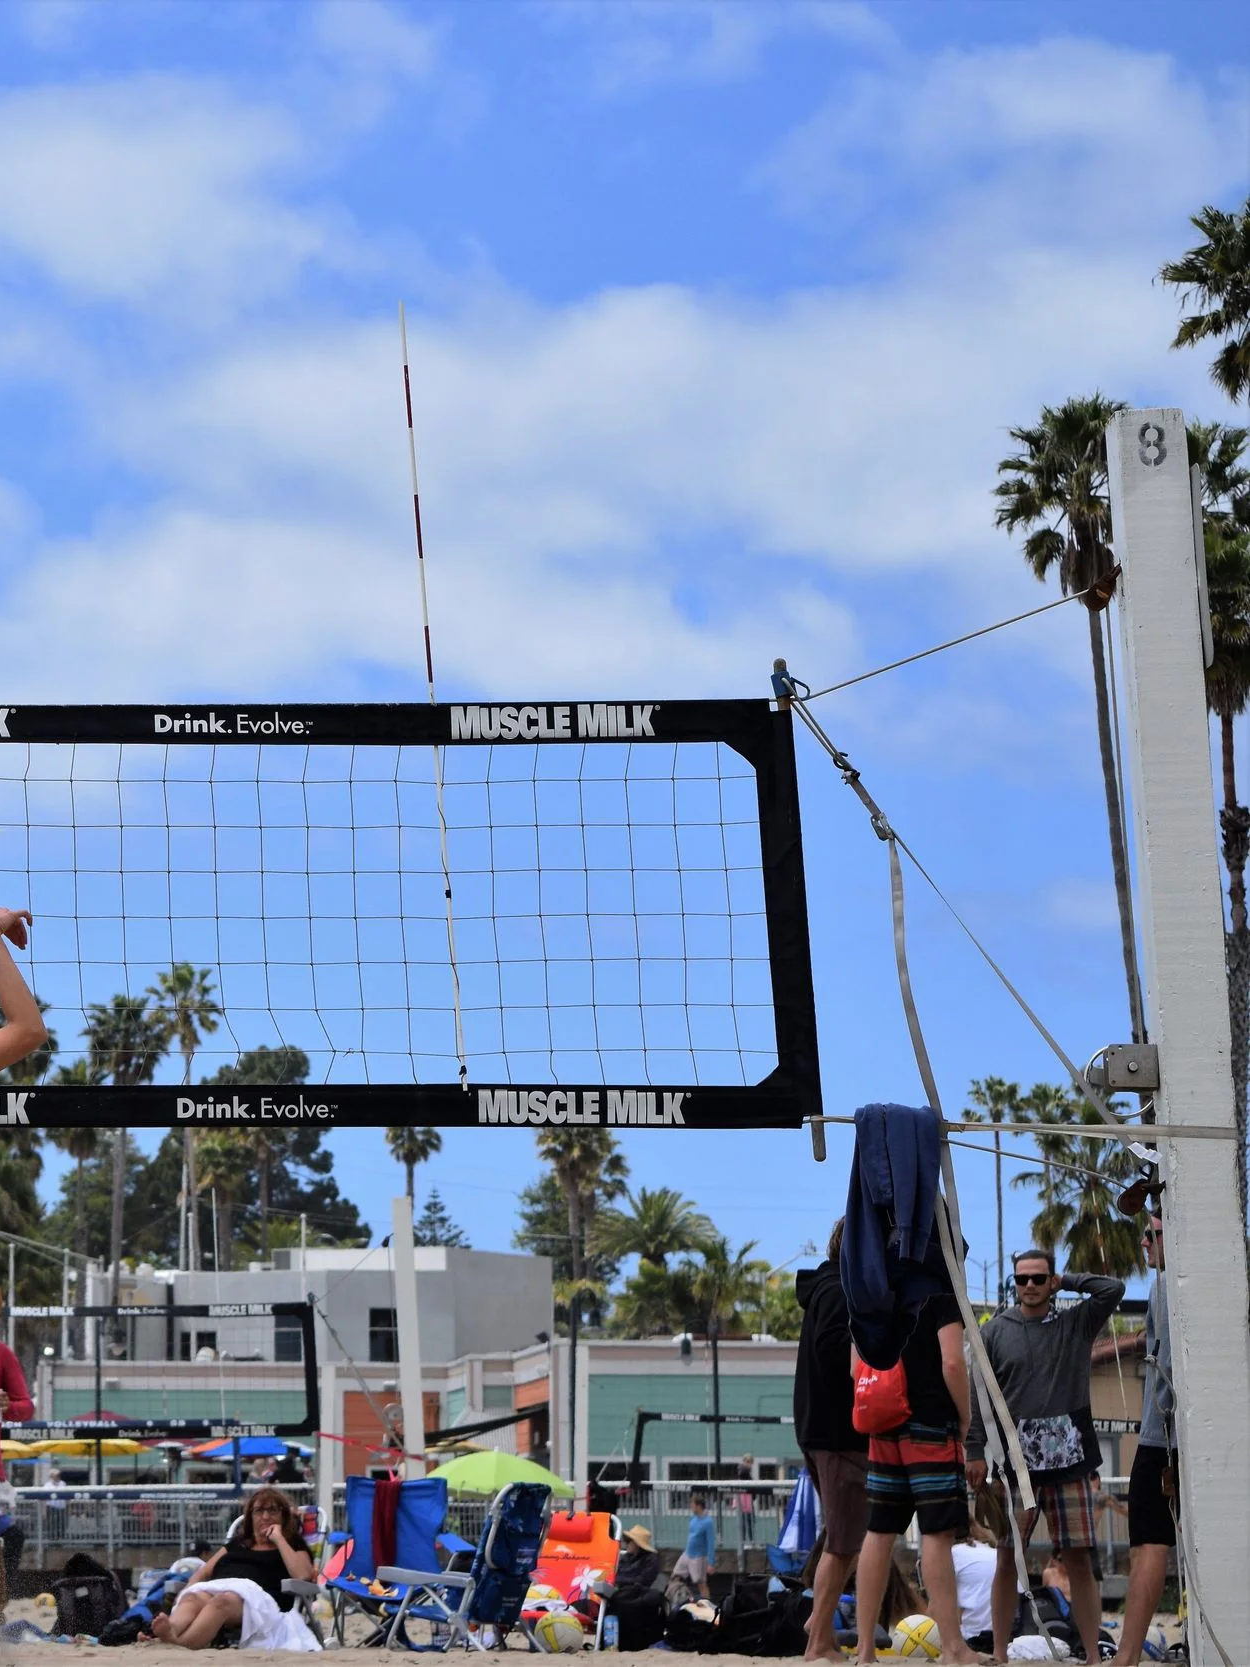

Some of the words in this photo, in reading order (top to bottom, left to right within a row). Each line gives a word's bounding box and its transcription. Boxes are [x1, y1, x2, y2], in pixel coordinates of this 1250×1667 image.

[1138, 422, 1168, 468] 8
[450, 705, 572, 740] MUSCLE
[577, 704, 655, 738] MILK
[477, 1089, 600, 1125] MUSCLE
[606, 1089, 686, 1125] MILK
[208, 1304, 247, 1317] MUSCLE
[247, 1303, 273, 1316] MILK
